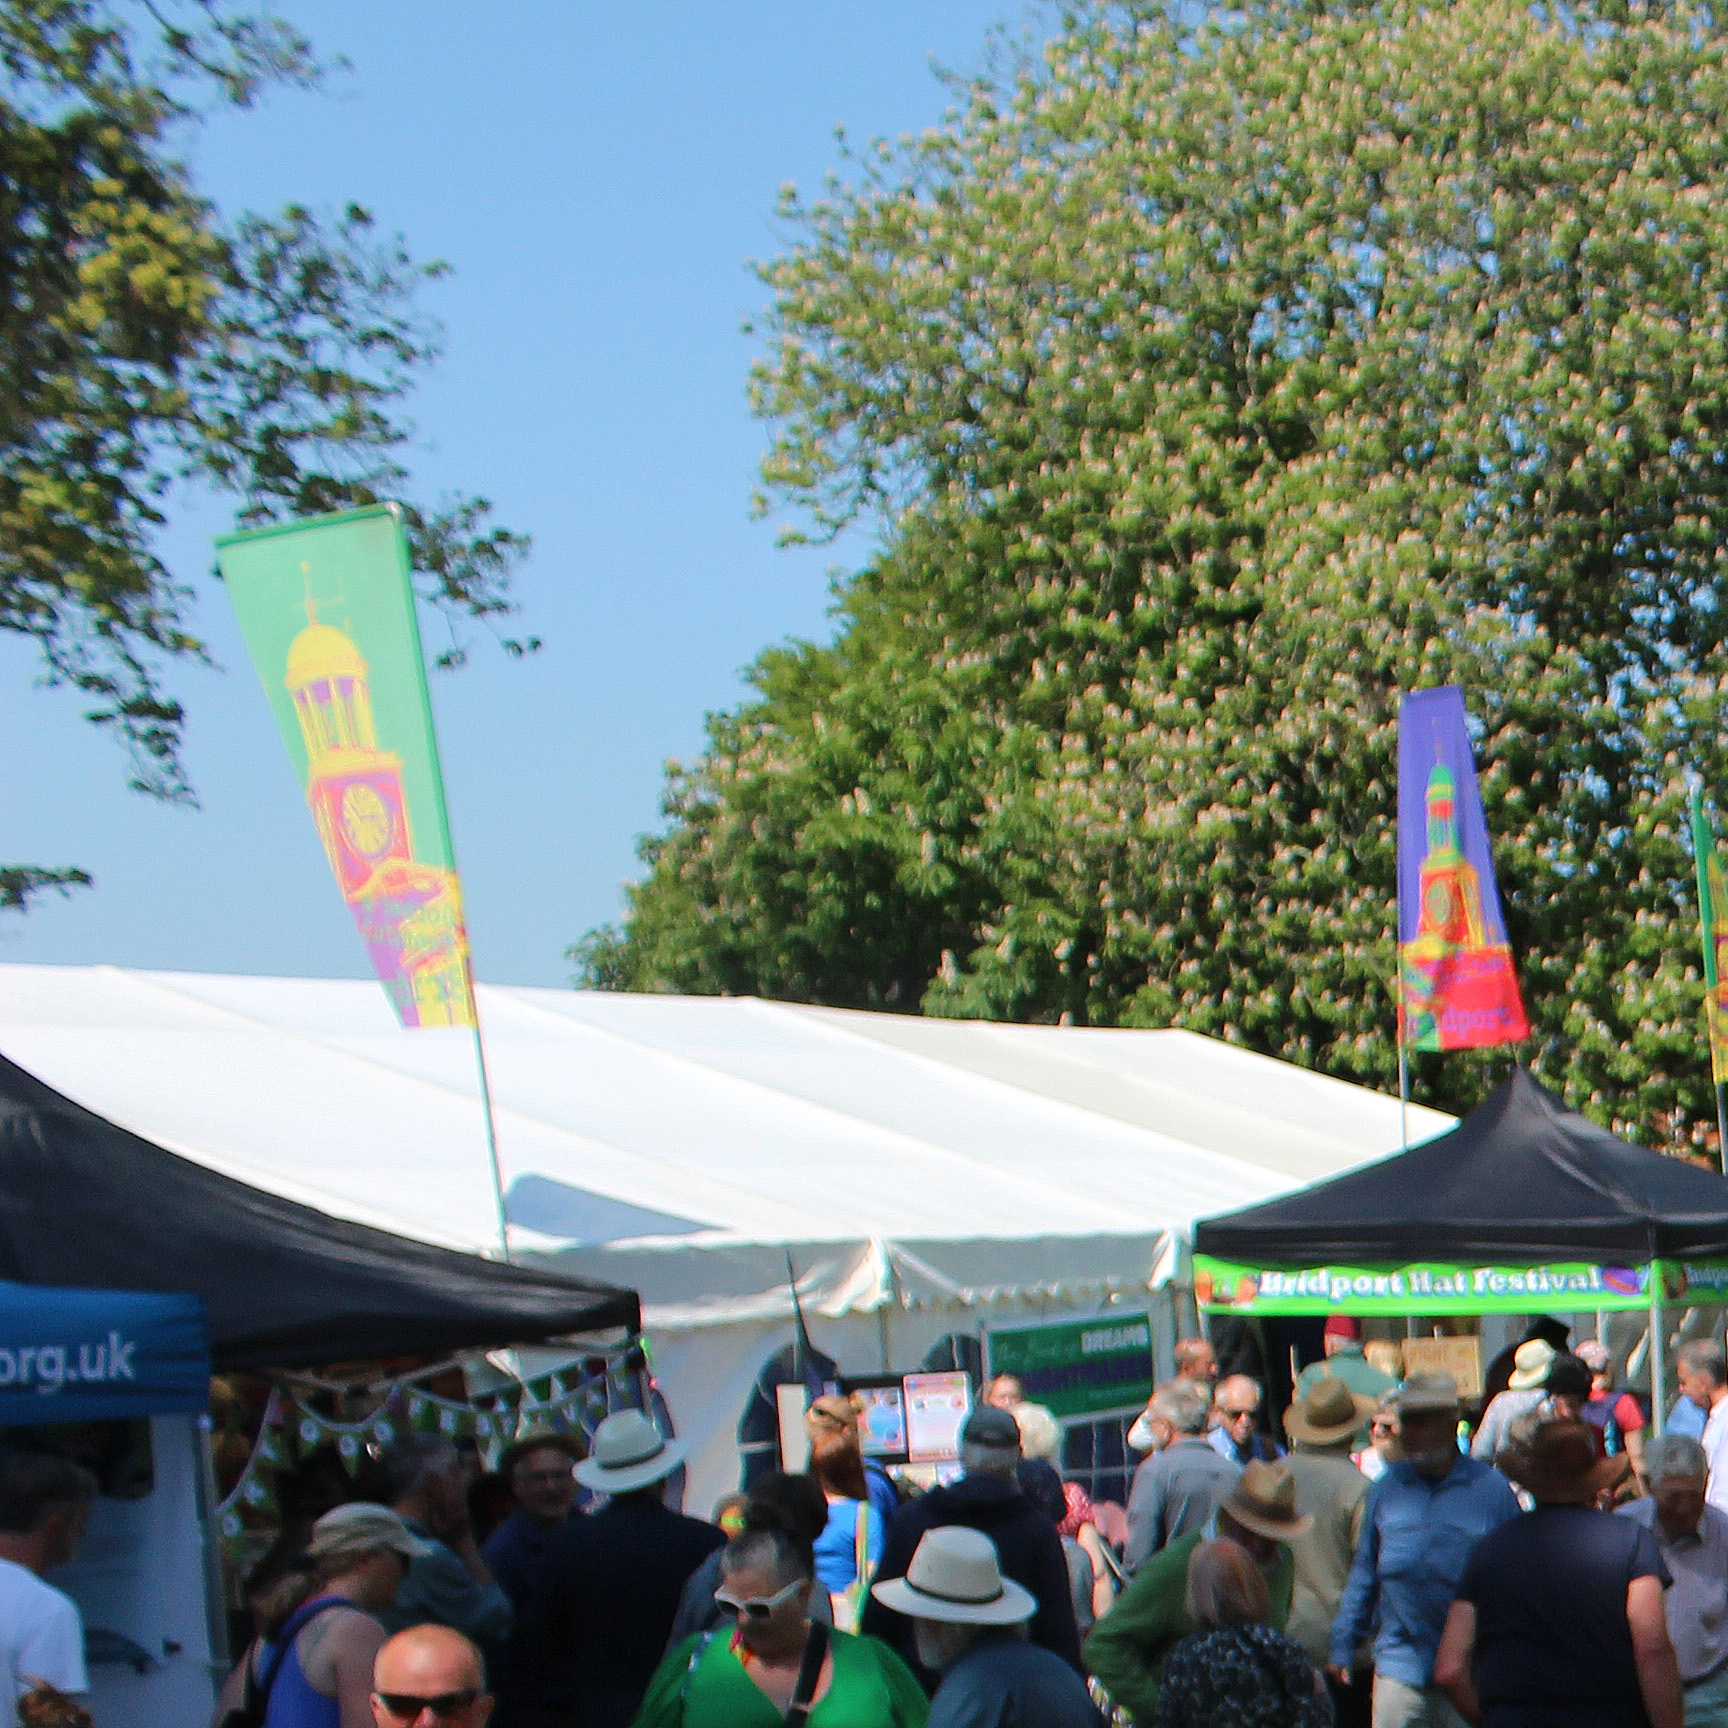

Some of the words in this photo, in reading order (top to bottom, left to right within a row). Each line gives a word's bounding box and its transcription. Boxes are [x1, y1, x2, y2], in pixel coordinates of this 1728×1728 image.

[1259, 1267, 1402, 1301] Bridport
[1408, 1269, 1468, 1295] Hat
[1473, 1266, 1600, 1295] Festival
